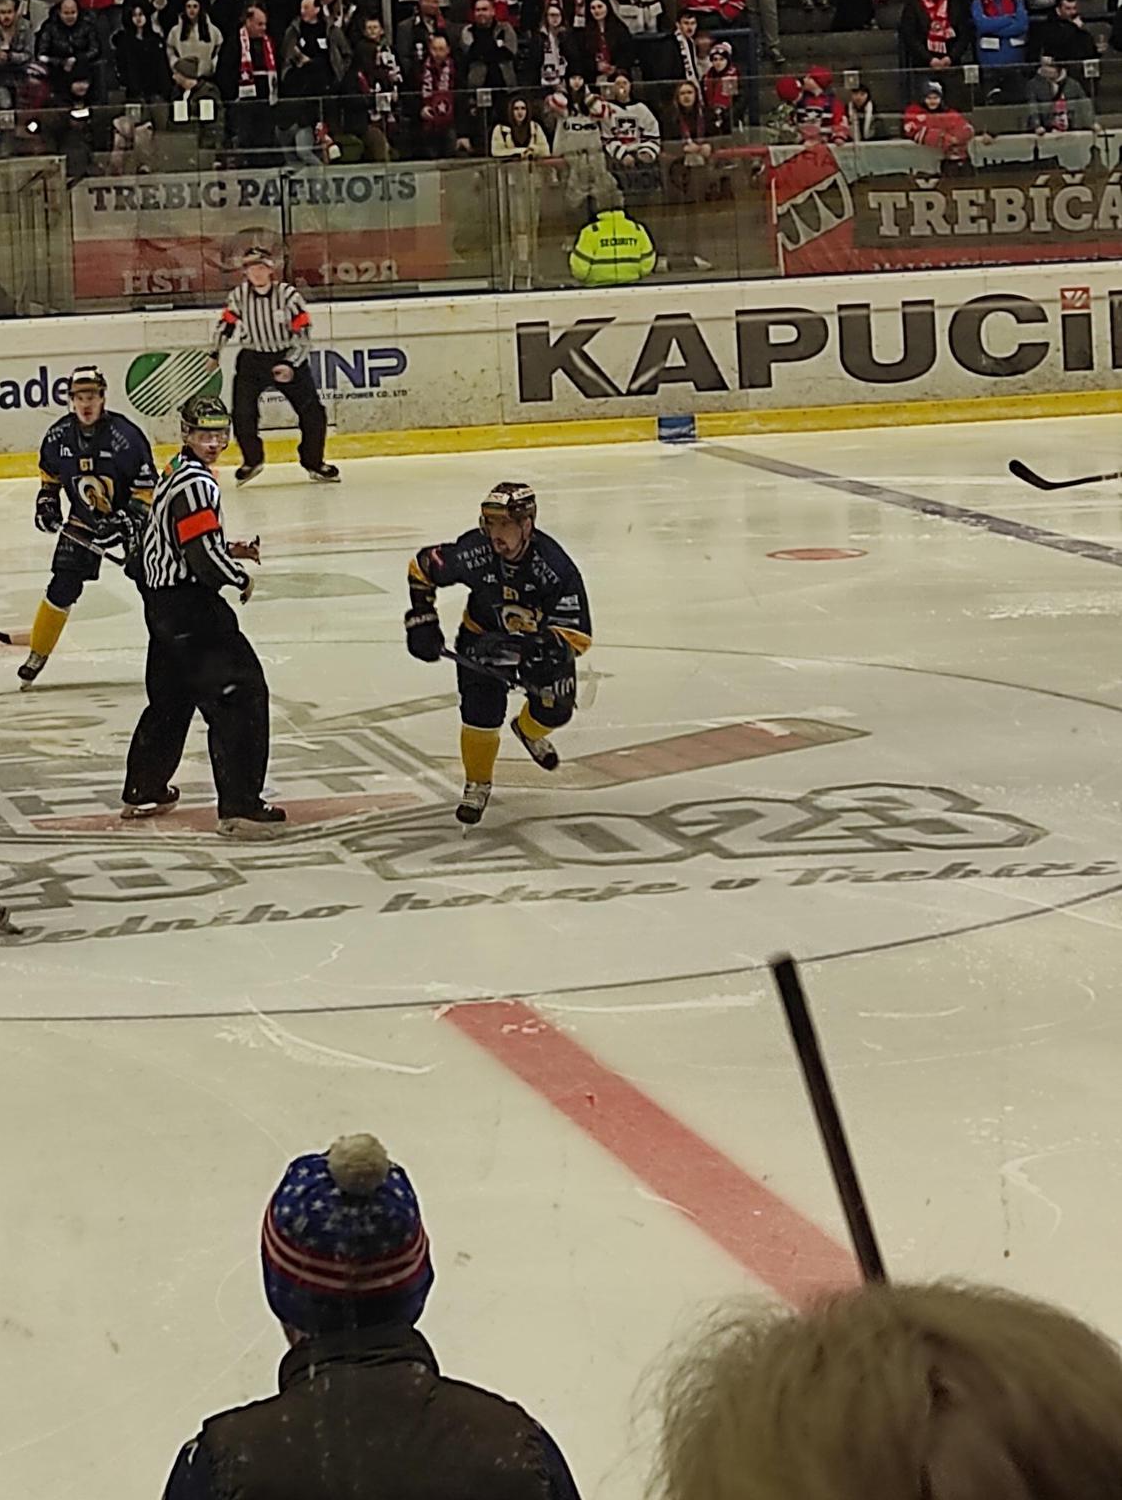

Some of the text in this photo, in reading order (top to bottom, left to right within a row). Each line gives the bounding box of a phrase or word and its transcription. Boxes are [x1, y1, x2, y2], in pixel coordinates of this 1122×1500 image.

[89, 171, 417, 213] TREBIC PATRIOTS
[600, 237, 638, 248] SECURITY
[121, 268, 197, 296] HST
